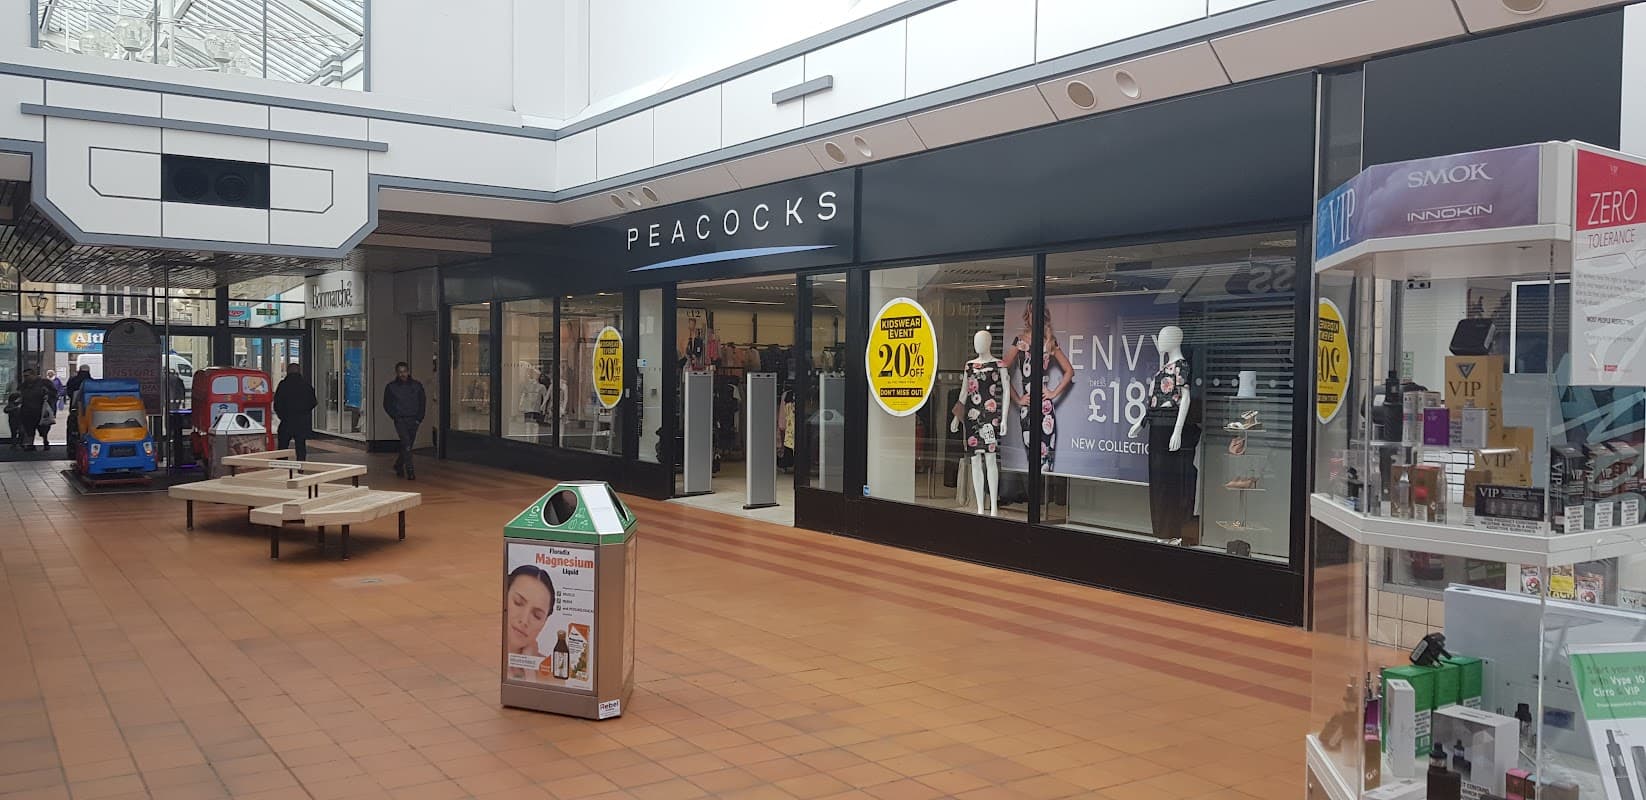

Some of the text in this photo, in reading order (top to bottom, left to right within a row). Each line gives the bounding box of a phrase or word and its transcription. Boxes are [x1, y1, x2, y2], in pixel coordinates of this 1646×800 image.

[1408, 163, 1493, 188] SMOK
[1408, 204, 1492, 222] INNOKIN
[1588, 189, 1638, 225] ZERO
[627, 191, 837, 250] PEACOCKS
[1329, 188, 1356, 249] VIP
[1588, 229, 1636, 249] TOLERANCE
[881, 318, 921, 329] KIDSWEAR
[889, 328, 913, 338] EVENT
[878, 343, 924, 378] 20% OFF
[880, 388, 923, 396] DON'T MISS OUT
[1448, 381, 1481, 397] VIP
[1071, 438, 1095, 449] NEW
[1482, 454, 1512, 467] VIP
[1552, 462, 1563, 485] VIP
[1480, 487, 1500, 498] VIP
[536, 553, 594, 569] Magnesium
[562, 568, 579, 576] Liquid
